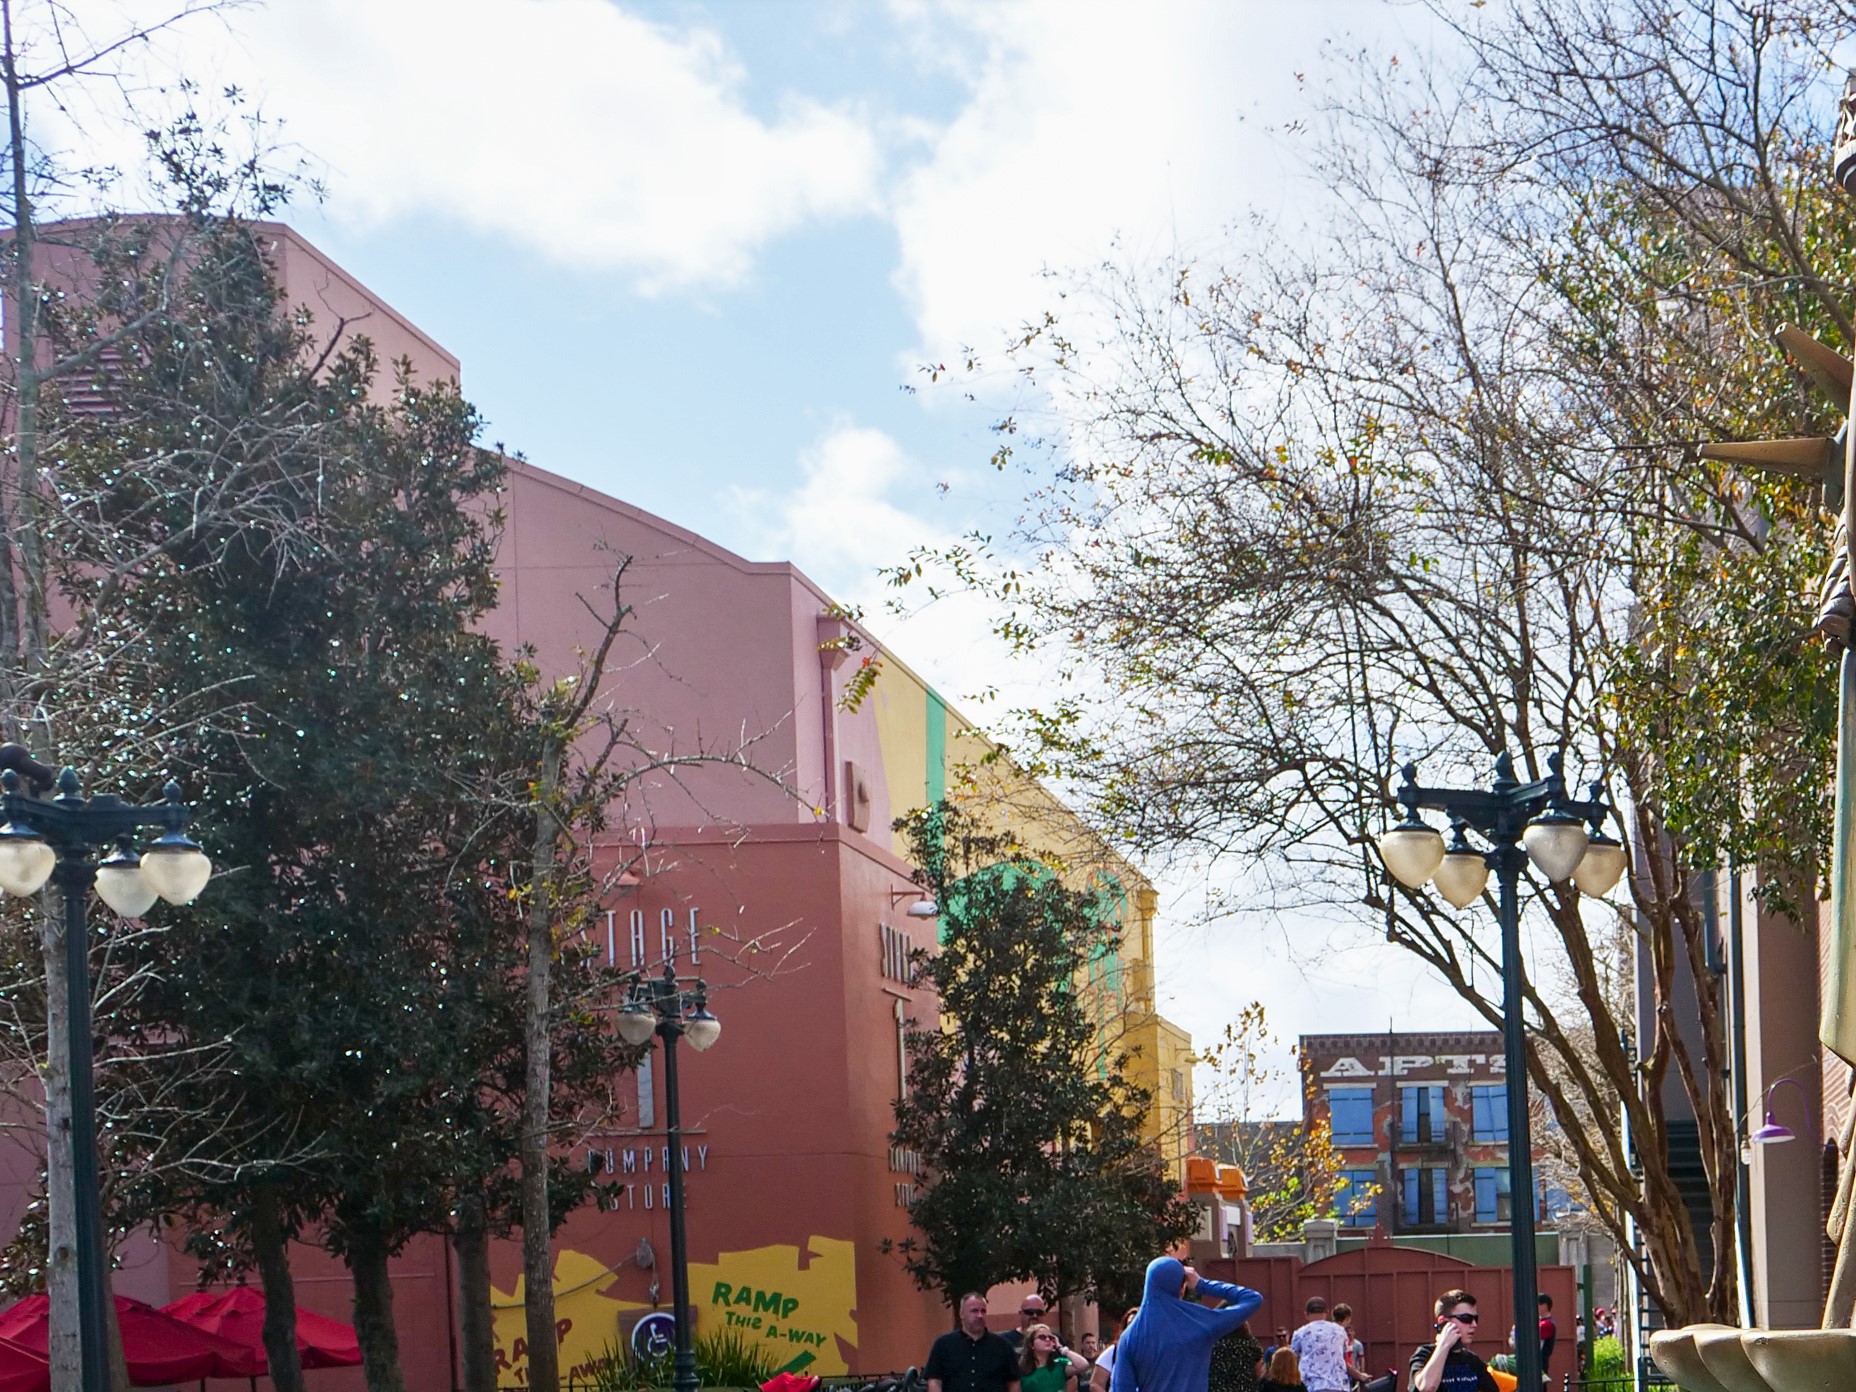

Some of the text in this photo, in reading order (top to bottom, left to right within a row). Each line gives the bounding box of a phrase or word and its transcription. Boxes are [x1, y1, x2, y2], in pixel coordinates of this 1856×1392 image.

[712, 1281, 800, 1320] RAMP
[494, 1318, 573, 1377] RAP
[765, 1324, 827, 1347] A-WAY
